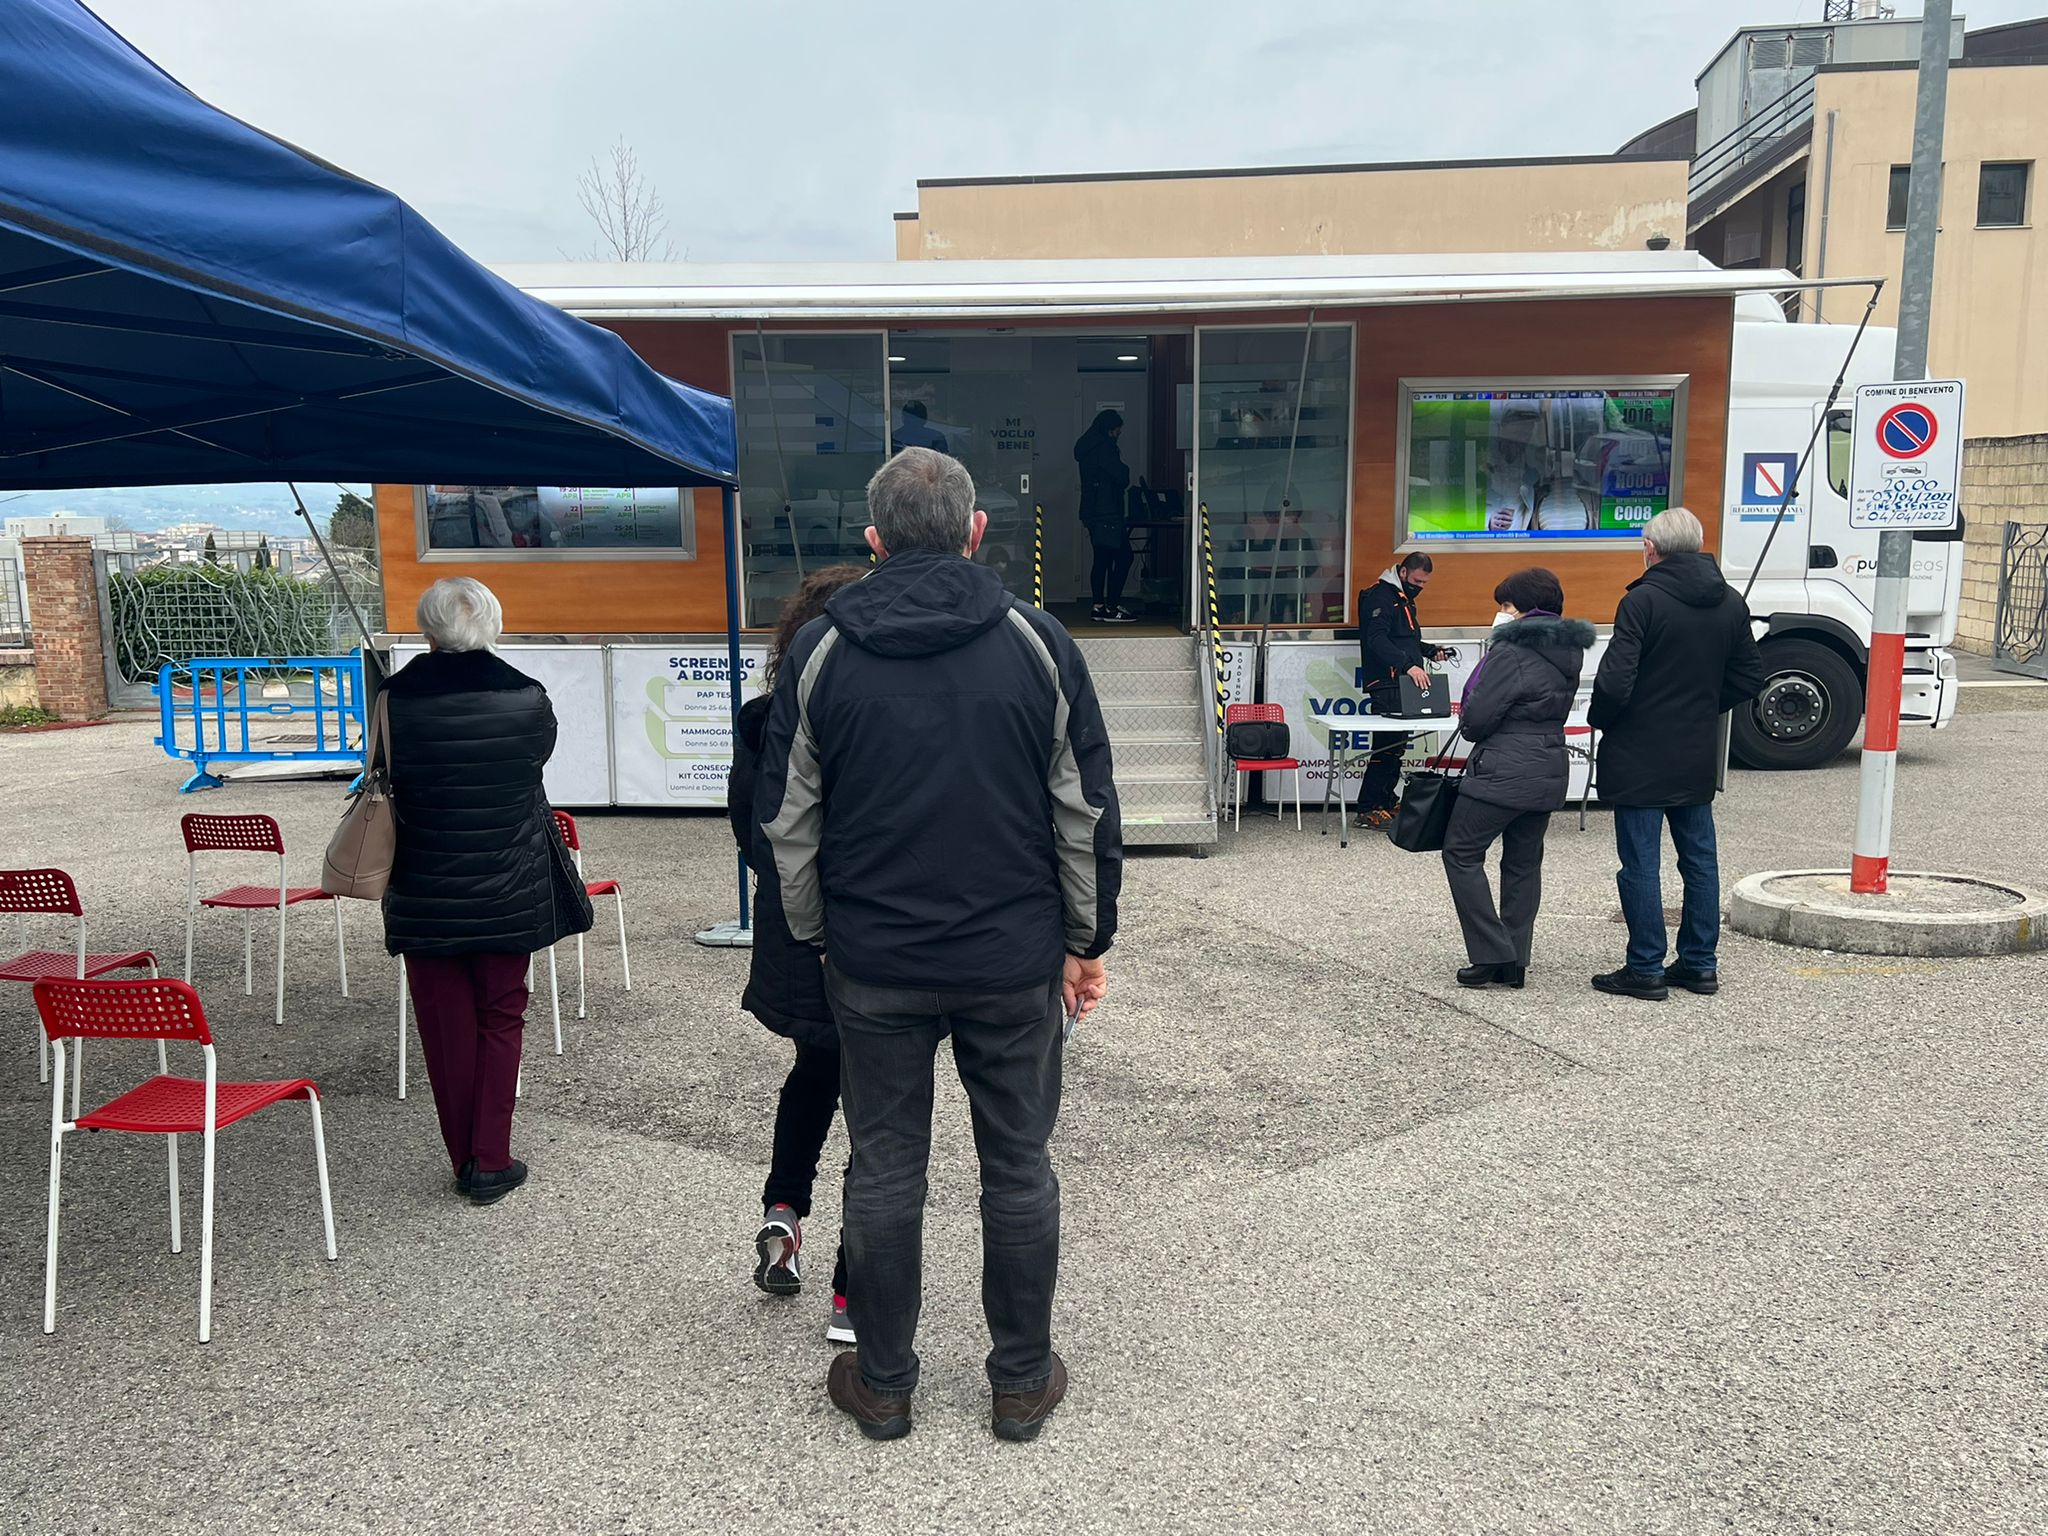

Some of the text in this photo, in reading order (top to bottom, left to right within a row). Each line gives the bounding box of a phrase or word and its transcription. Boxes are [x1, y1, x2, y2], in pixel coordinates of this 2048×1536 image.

[1865, 386, 1954, 396] COMUNE DI BENEVENTO
[1006, 417, 1021, 427] MI
[990, 430, 1035, 438] VOGLIO
[997, 441, 1030, 450] BENE
[1883, 479, 1938, 492] 20.00
[1868, 511, 1946, 525] 04/04/2022
[669, 657, 755, 669] SCREENG
[677, 670, 688, 680] A
